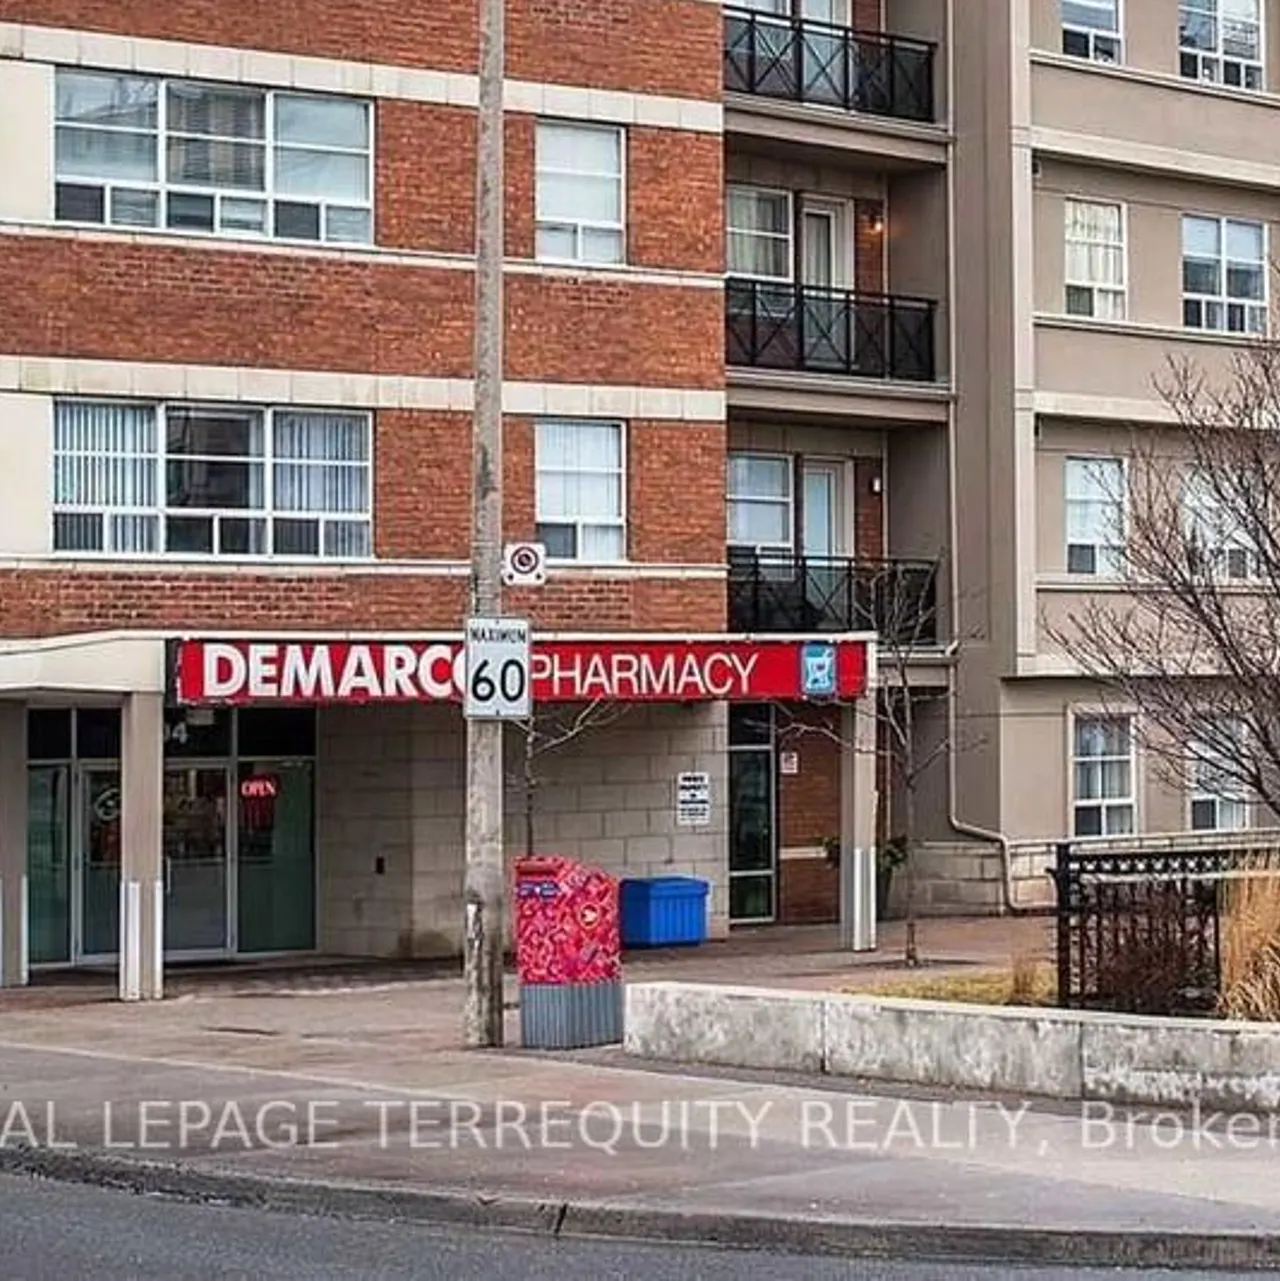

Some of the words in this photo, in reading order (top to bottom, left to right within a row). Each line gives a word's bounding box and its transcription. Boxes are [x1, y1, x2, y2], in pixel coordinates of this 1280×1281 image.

[202, 644, 467, 698] DEMARC
[531, 652, 760, 696] PHARMACY
[472, 658, 526, 703] 60
